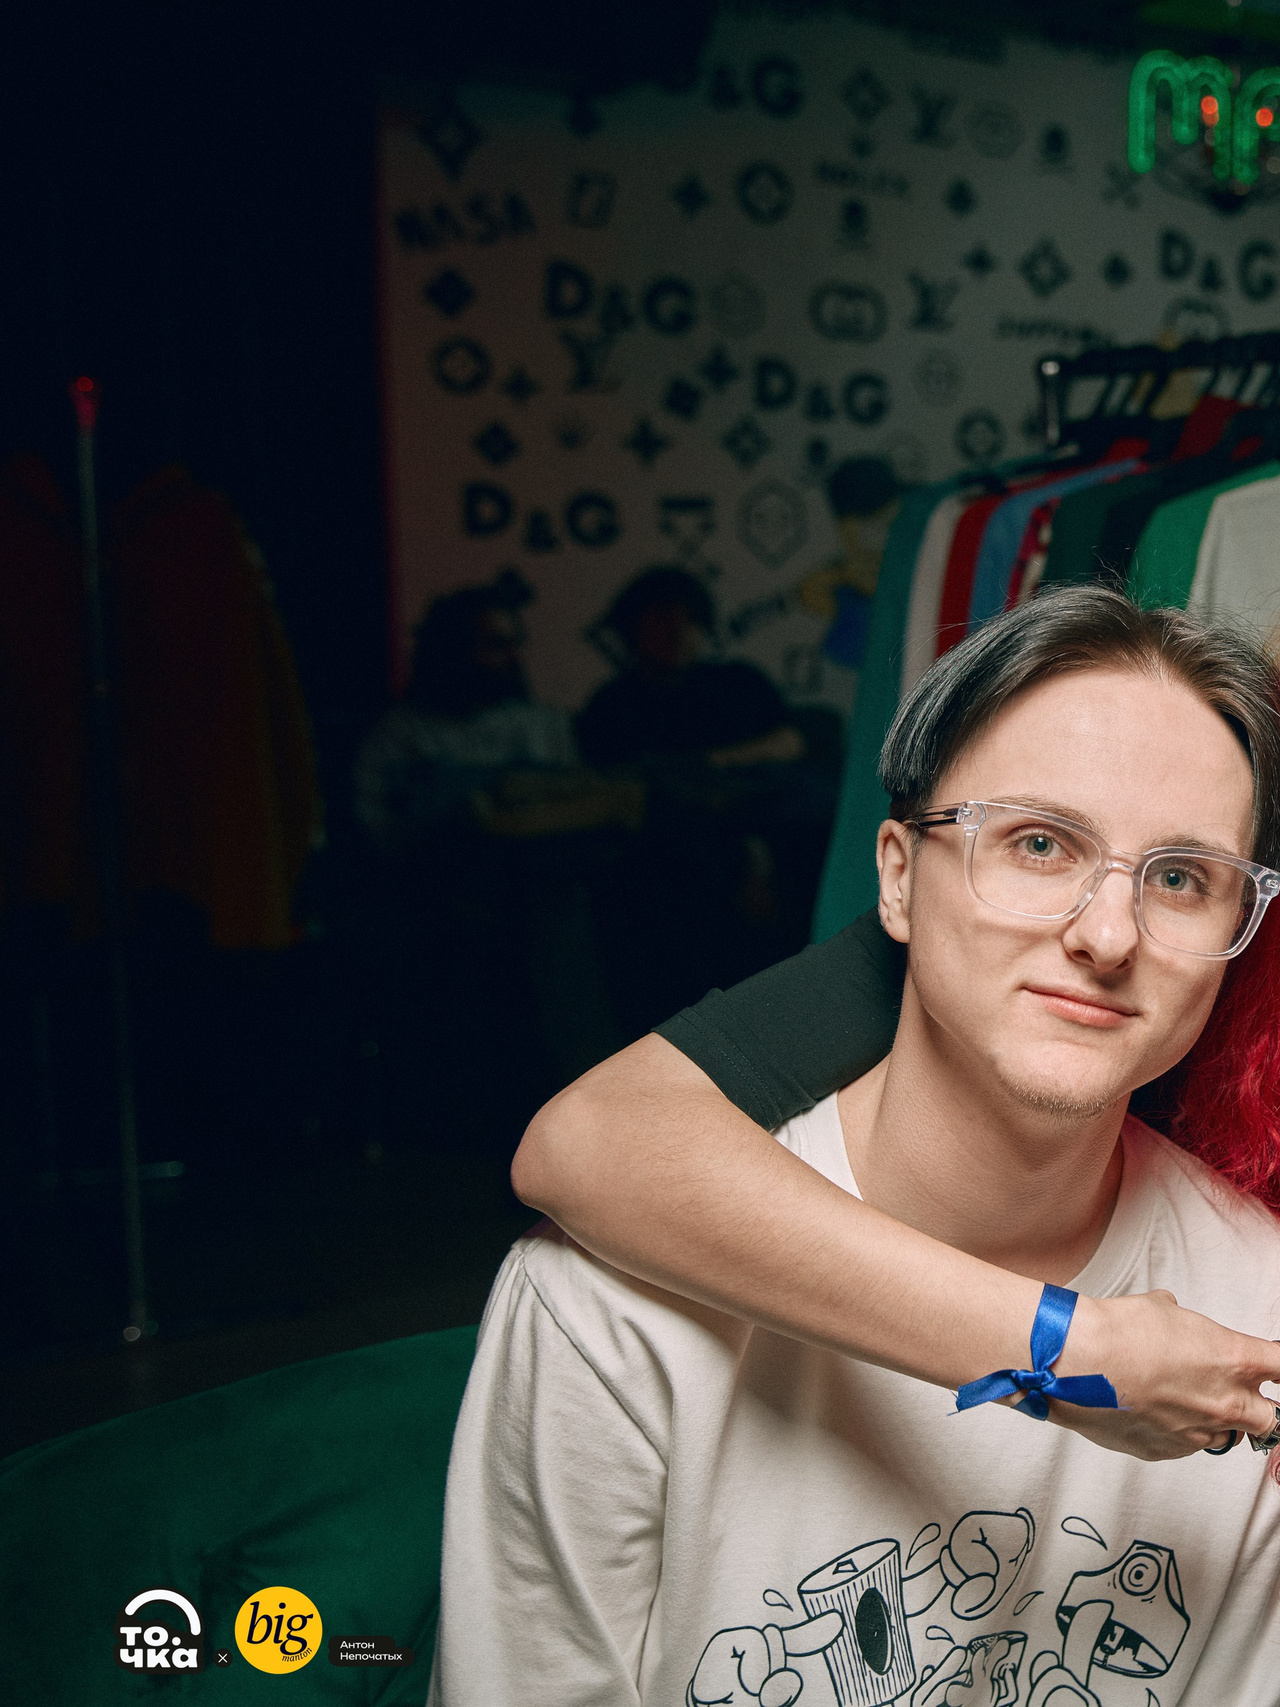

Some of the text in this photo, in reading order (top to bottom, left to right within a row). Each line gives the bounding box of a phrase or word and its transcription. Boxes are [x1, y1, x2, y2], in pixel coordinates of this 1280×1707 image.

[395, 190, 534, 250] NASA
[1160, 227, 1277, 300] D&G
[546, 261, 698, 334] D&G
[755, 358, 887, 423] D&G
[465, 484, 620, 549] D&G
